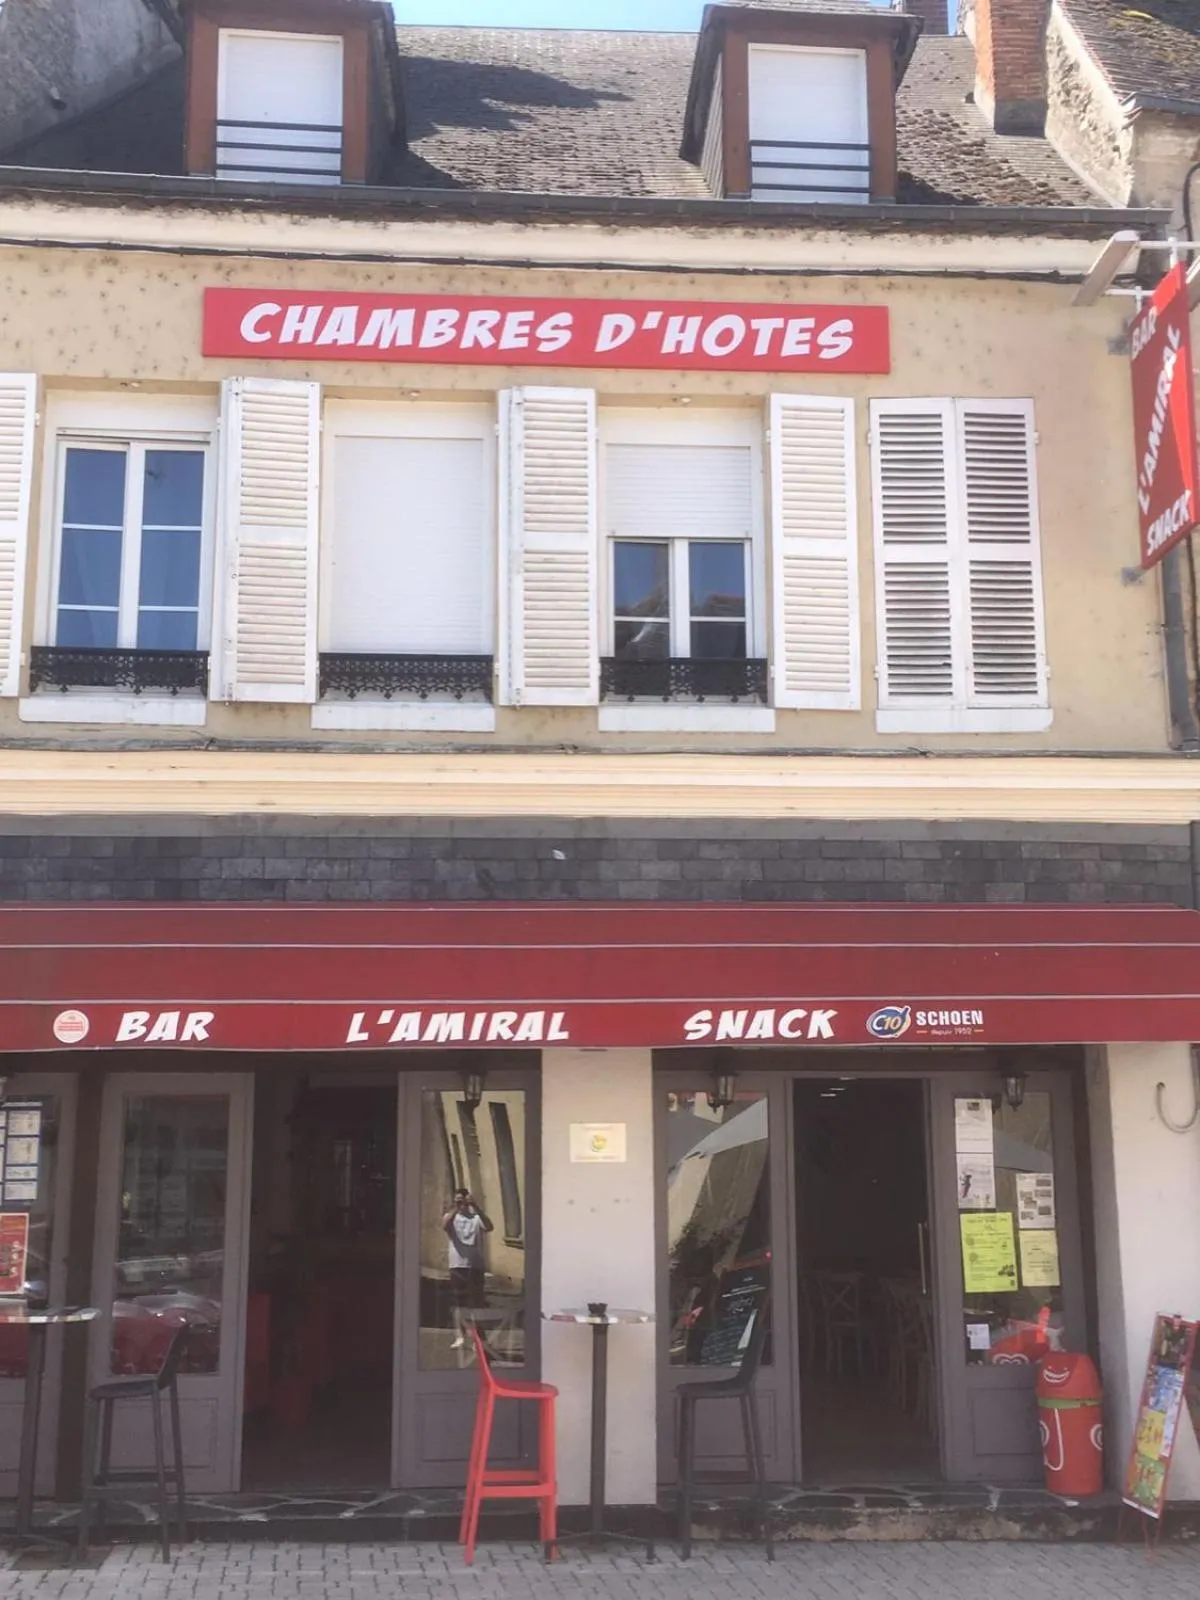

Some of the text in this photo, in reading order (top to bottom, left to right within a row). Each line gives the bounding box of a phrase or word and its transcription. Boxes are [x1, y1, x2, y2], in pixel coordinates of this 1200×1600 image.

[240, 302, 853, 359] CHAMBRES D'HOTES
[1131, 305, 1157, 361] BAR
[1139, 323, 1181, 515] L'AMIRAL
[1147, 489, 1191, 556] SNACK
[115, 1011, 214, 1042] BAR
[346, 1009, 569, 1043] L'AMIRAL
[683, 1009, 838, 1041] SNACK
[872, 1015, 902, 1030] C10
[916, 1010, 983, 1026] SCHOEN
